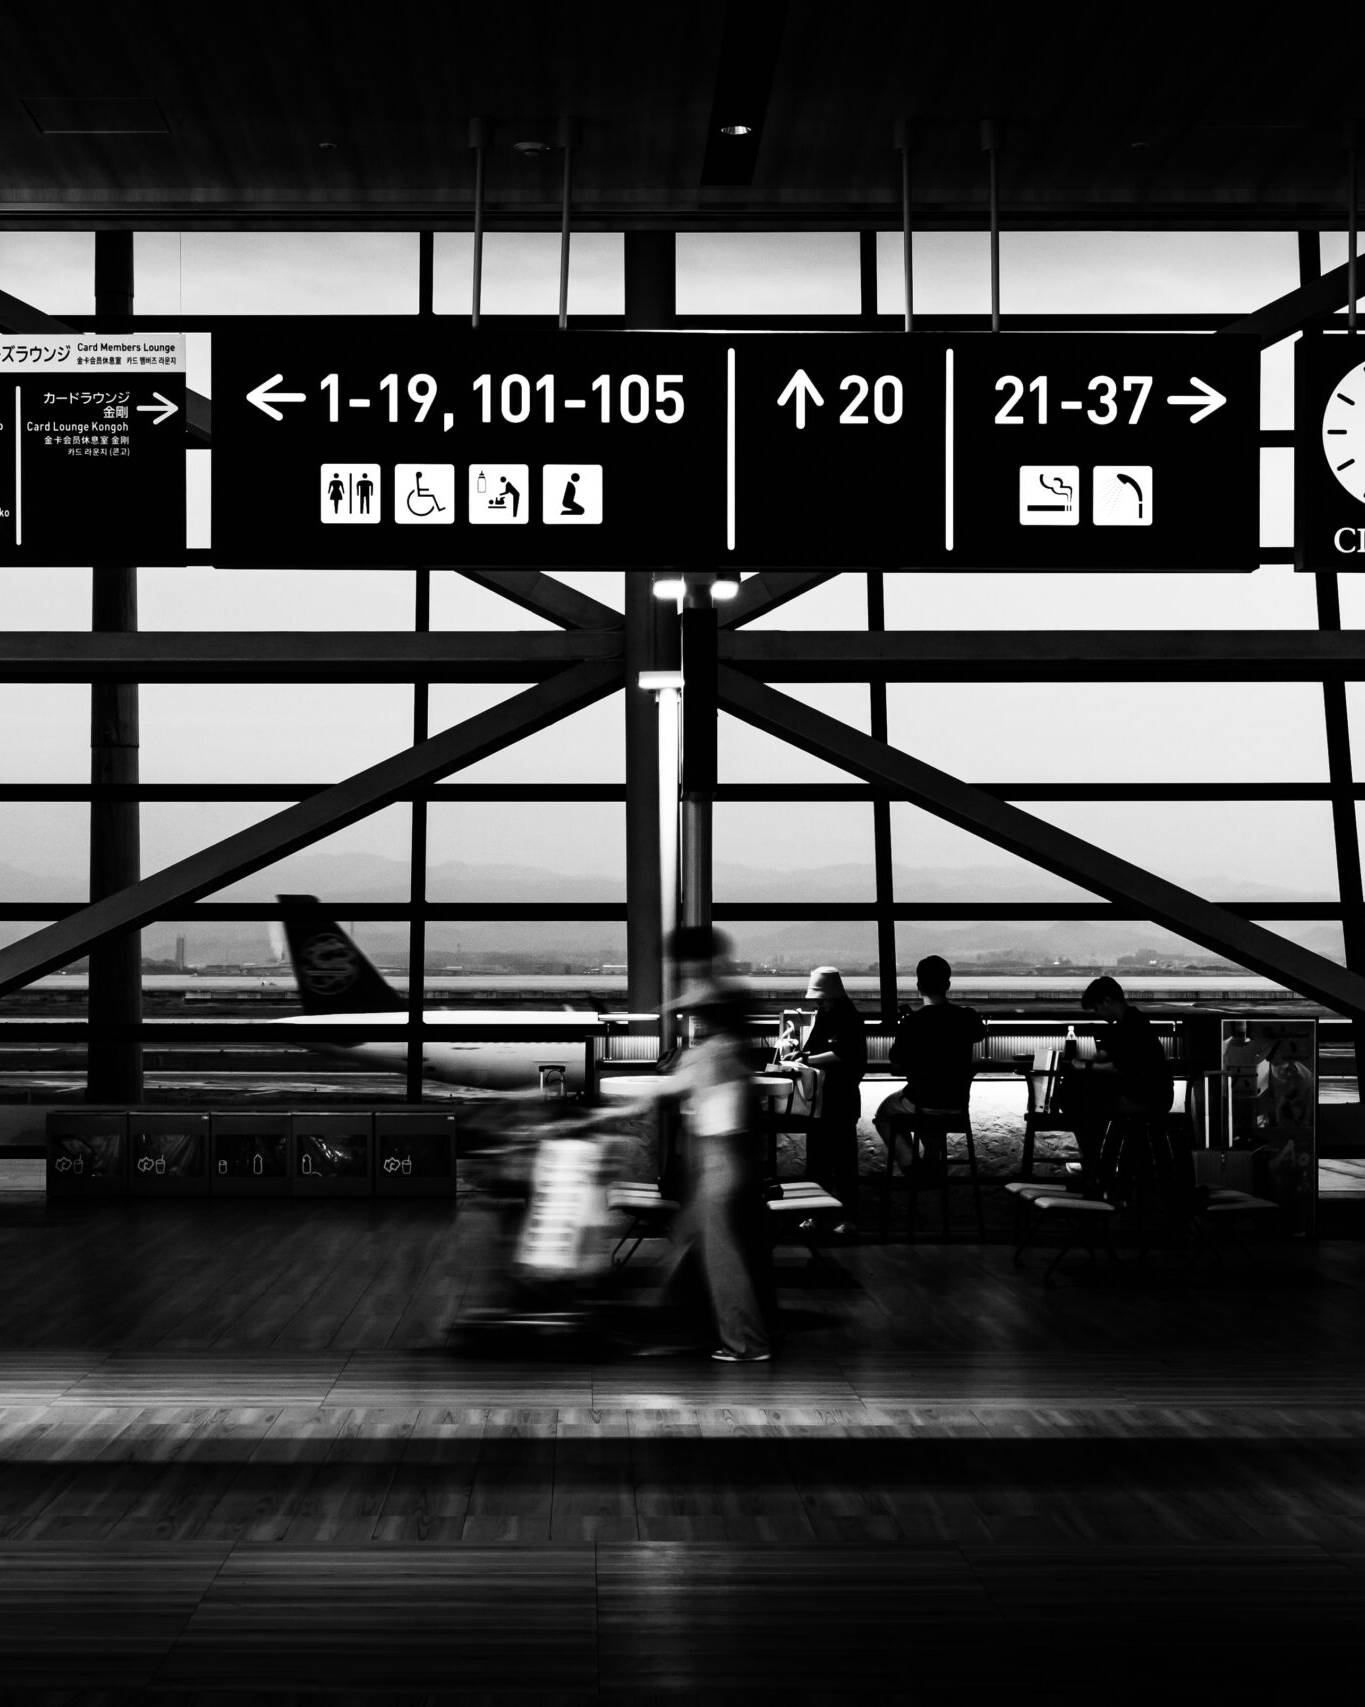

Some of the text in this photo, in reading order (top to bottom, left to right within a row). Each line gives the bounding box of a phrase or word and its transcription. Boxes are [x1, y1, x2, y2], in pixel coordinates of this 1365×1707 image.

[0, 344, 71, 363] ズラウンジ
[76, 342, 176, 354] Card Members Lounge
[43, 391, 130, 405] カードラウンジ
[319, 373, 685, 433] 1-19, 101-105
[839, 374, 904, 425] 20
[994, 375, 1153, 426] 21-37
[103, 405, 129, 419] 金剛
[26, 421, 129, 434] Card Lounge Kongoh
[44, 435, 109, 445] 金卡会员休息室
[84, 447, 108, 457] 라운지
